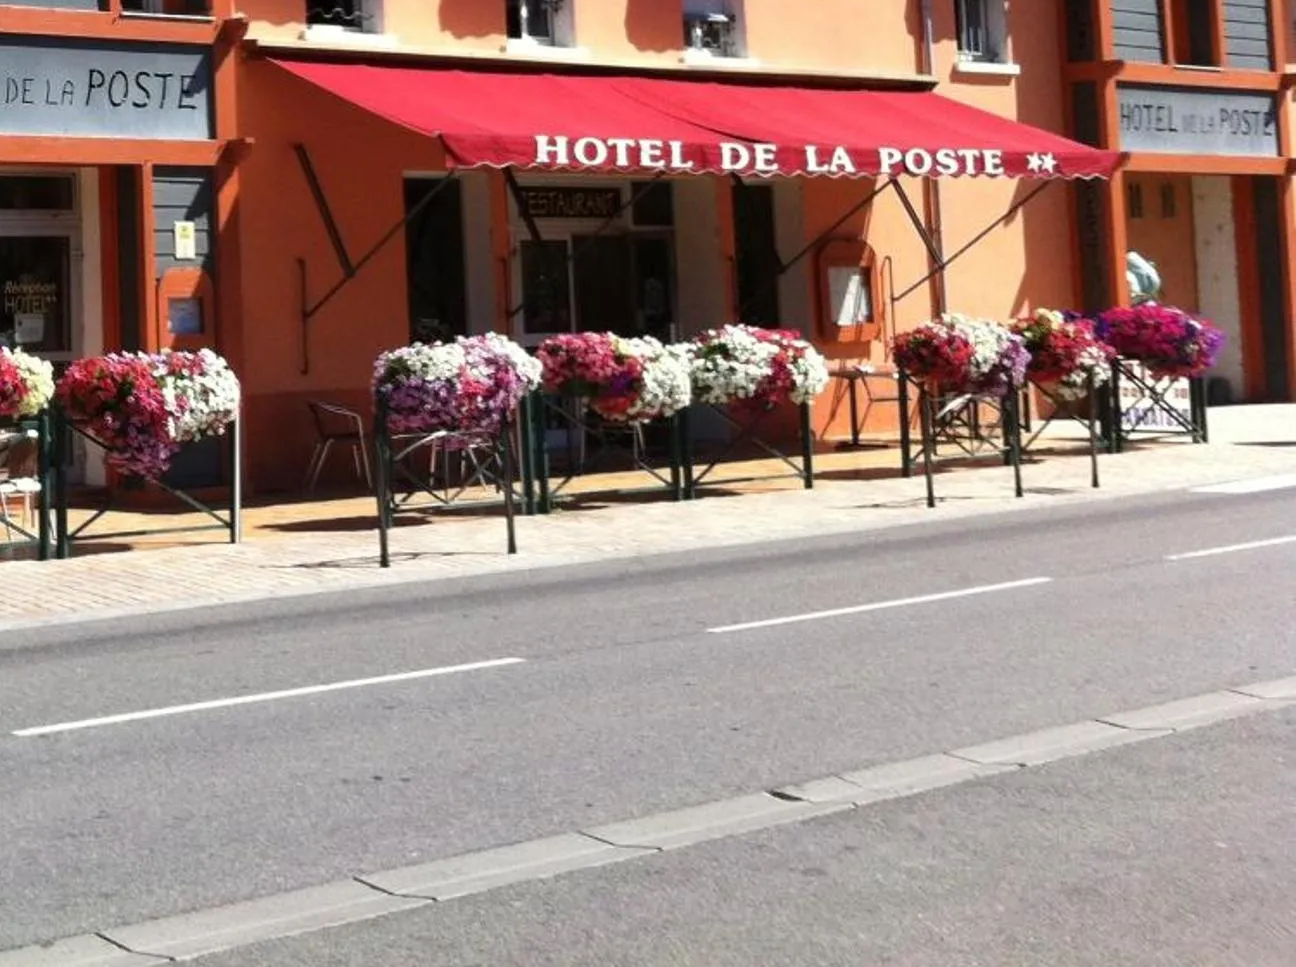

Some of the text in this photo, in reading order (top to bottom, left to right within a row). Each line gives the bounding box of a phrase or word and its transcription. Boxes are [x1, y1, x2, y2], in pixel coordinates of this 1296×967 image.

[5, 76, 35, 104] DE
[45, 79, 75, 106] LA
[85, 67, 197, 110] POSTE
[1120, 103, 1178, 133] HOTEL
[1218, 107, 1274, 137] POSTE
[534, 135, 1003, 175] HOTEL DE LA POSTE
